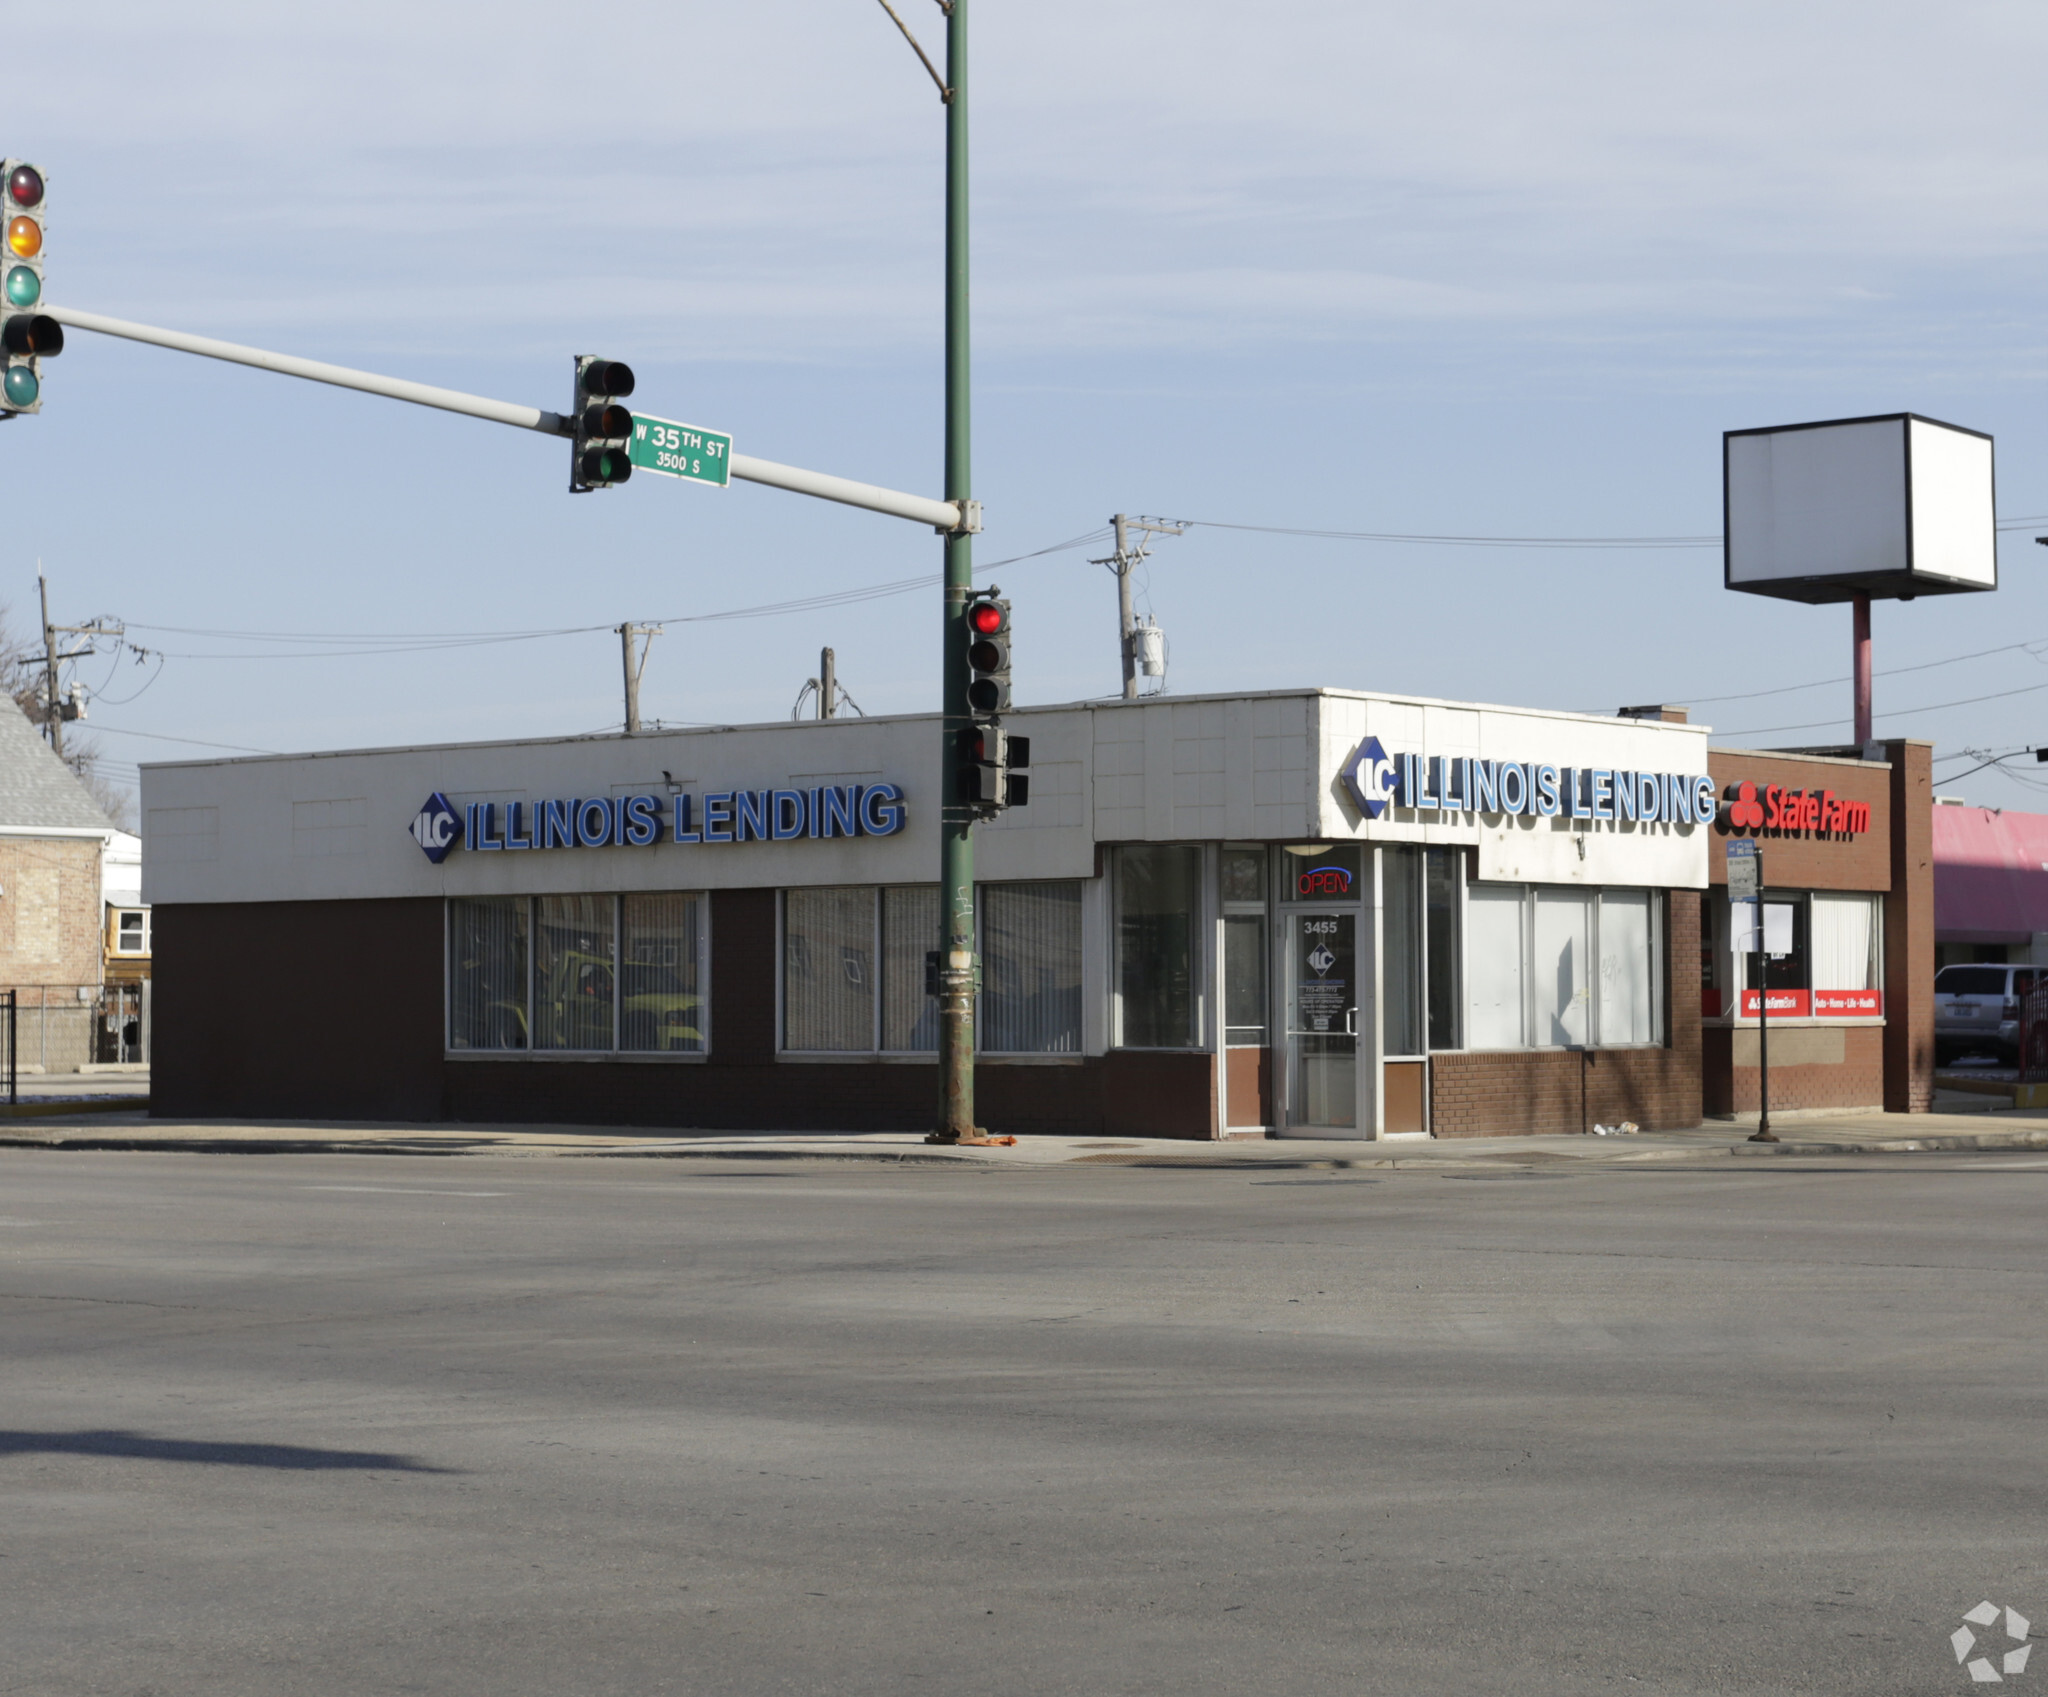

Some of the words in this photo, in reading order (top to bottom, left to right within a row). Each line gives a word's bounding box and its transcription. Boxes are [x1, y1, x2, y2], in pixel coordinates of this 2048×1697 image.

[636, 423, 647, 440] W
[651, 426, 702, 450] 35TH
[706, 441, 725, 458] ST
[656, 451, 687, 471] 3500
[692, 459, 700, 474] S
[1357, 758, 1396, 801] ILC
[1404, 752, 1560, 817] ILLINOIS
[1571, 767, 1715, 825] LENDING
[413, 811, 454, 848] ILC
[465, 795, 658, 851] ILLINOIS
[674, 783, 900, 843] LENDING
[1298, 873, 1348, 894] OPEN
[1304, 921, 1337, 934] 3455
[1847, 998, 1857, 1008] Life
